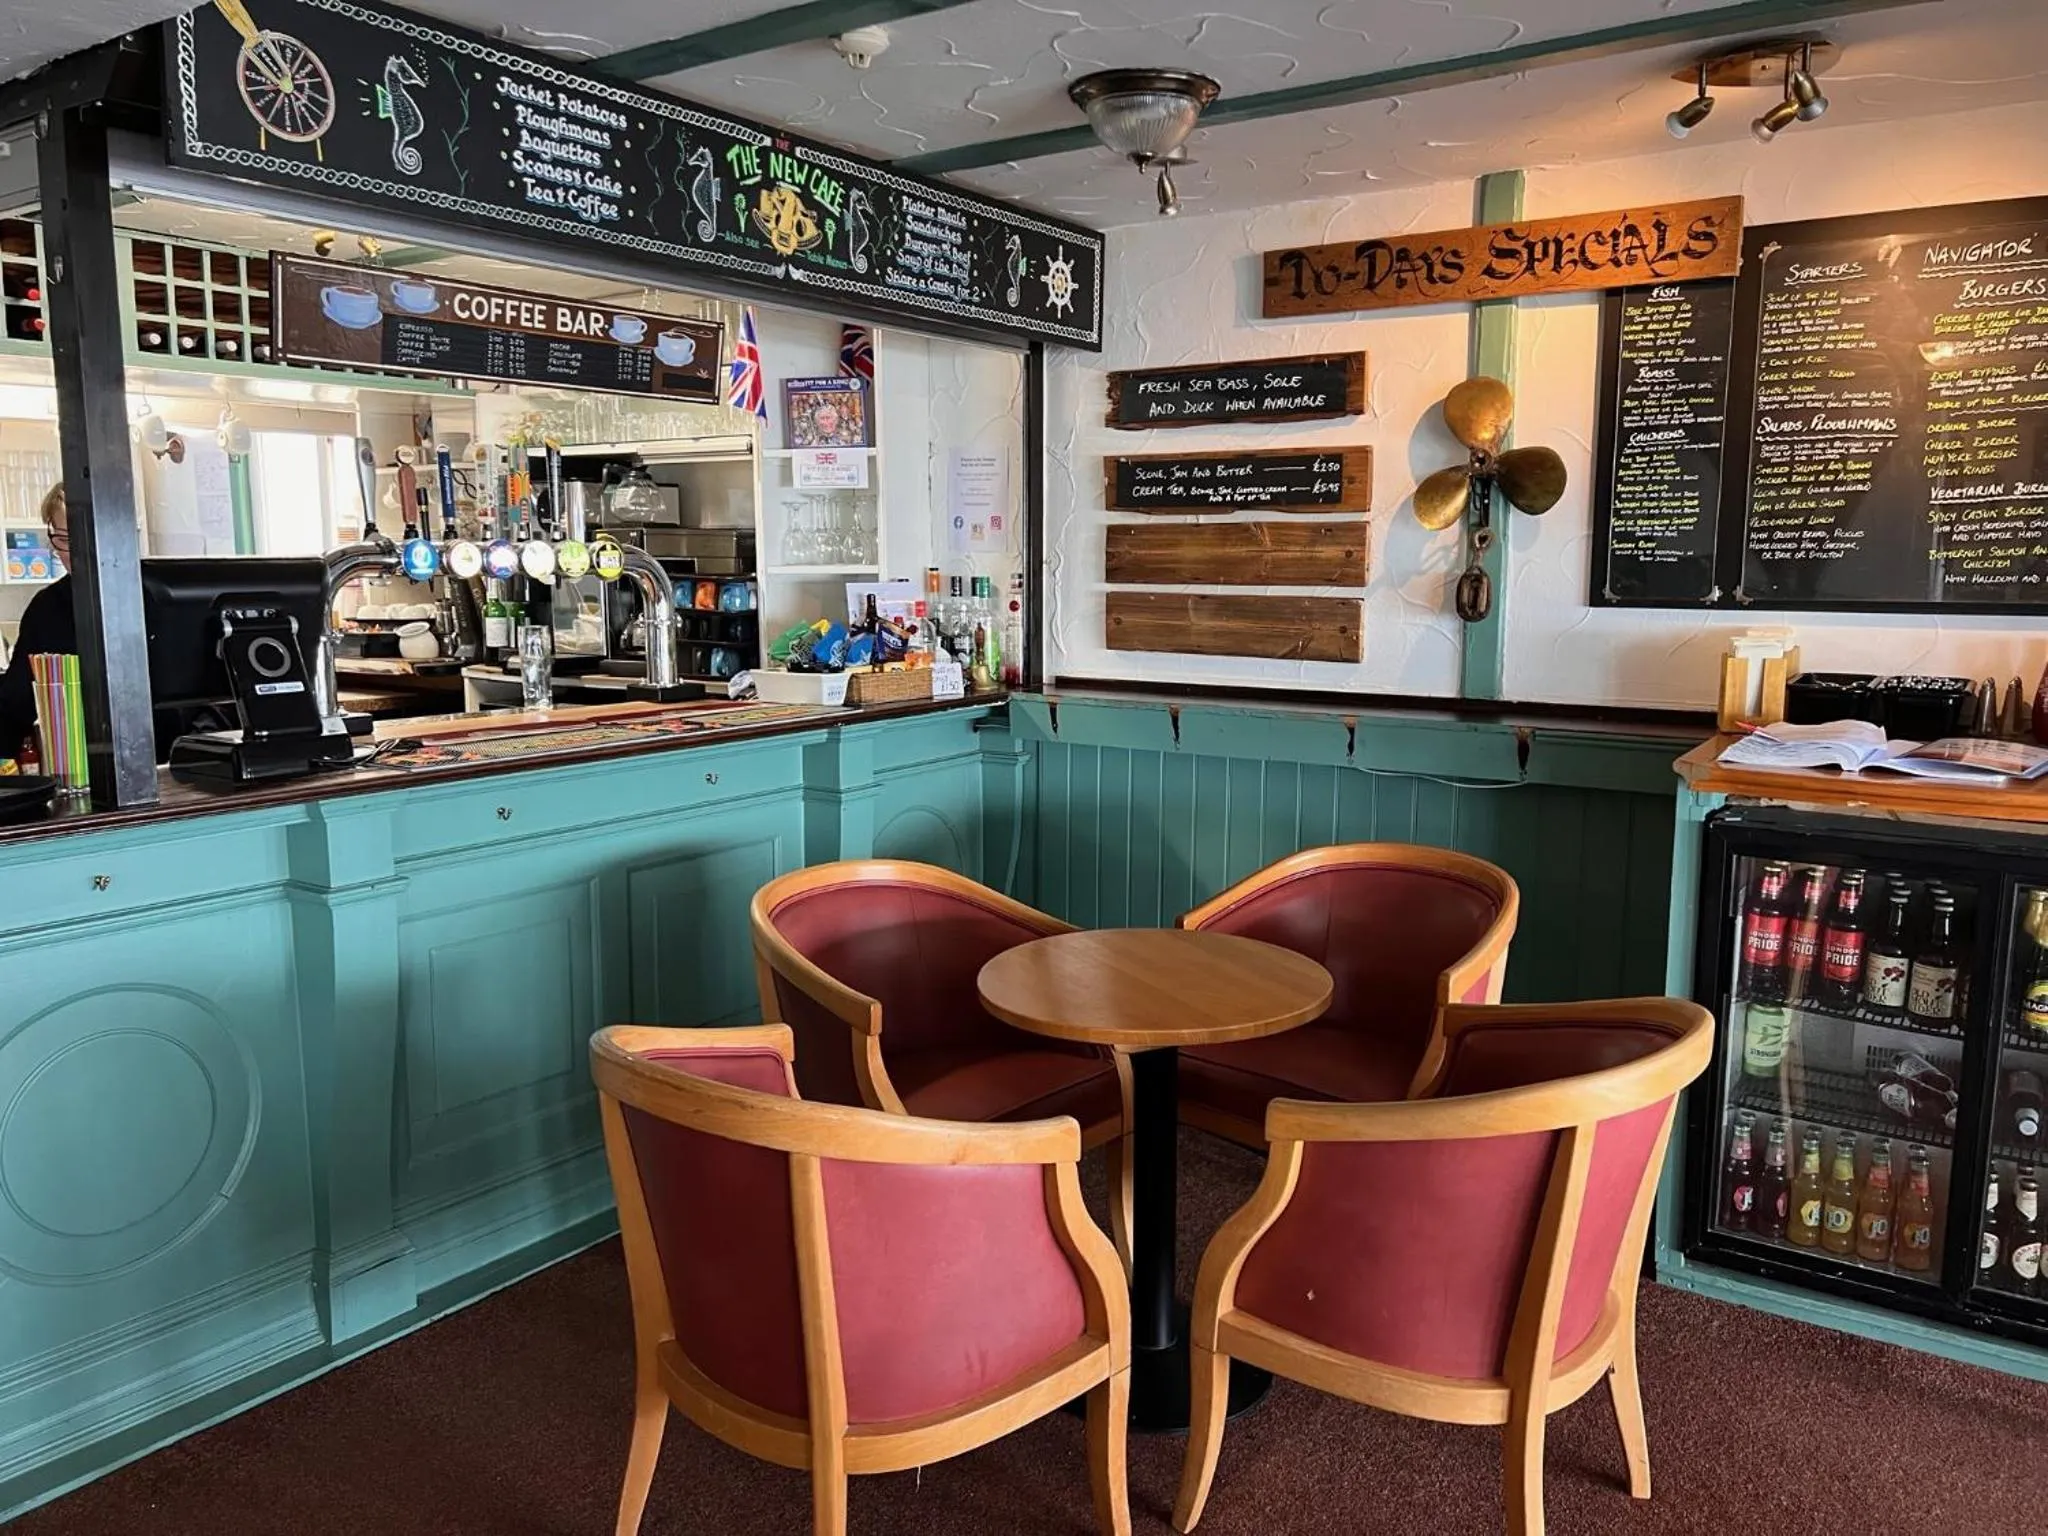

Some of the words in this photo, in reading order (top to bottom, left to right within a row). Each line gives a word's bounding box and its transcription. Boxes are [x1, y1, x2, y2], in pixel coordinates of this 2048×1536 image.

[496, 76, 555, 109] Jacket
[558, 93, 627, 128] Potatoes
[515, 104, 612, 148] Ploughmans
[520, 128, 602, 166] Baguettes
[726, 144, 762, 179] THE
[770, 152, 809, 185] NEW
[585, 171, 623, 197] Cake
[522, 177, 555, 203] Tea
[568, 189, 620, 222] Coffee
[902, 196, 935, 218] Platter
[905, 214, 962, 244] Sandwiches
[896, 249, 922, 273] Soup
[953, 264, 970, 286] Day
[1784, 261, 1864, 282] STARTERS
[886, 267, 917, 287] Share
[919, 279, 926, 288] a
[973, 286, 980, 301] 2
[1652, 286, 1680, 298] FISH
[454, 292, 546, 330] COFFEE
[556, 307, 605, 337] BAR
[1639, 366, 1676, 378] ROASTS
[1930, 370, 1963, 381] EXTRA
[1138, 381, 1181, 395] FRESH
[1188, 379, 1212, 392] SEA
[1264, 374, 1302, 389] SOLE
[1150, 401, 1176, 417] AND
[1183, 400, 1214, 414] DUCK
[1226, 398, 1256, 412] WHEN
[1263, 395, 1327, 410] AVAILABLE
[1977, 418, 2017, 429] BURGER
[1925, 440, 1964, 450] CHEESE
[1972, 434, 2020, 446] BURGER
[1924, 455, 1944, 465] NEW
[1977, 449, 2017, 459] BURGER
[1170, 465, 1188, 480] JAM
[1192, 466, 1211, 478] AND
[1216, 464, 1253, 477] BUTTER
[1756, 464, 1790, 474] SMOKED
[1792, 463, 1825, 473] SALMON
[1963, 464, 1996, 475] RINGS
[1754, 477, 1788, 486] CHICKEN
[1132, 485, 1163, 497] CREAM
[1930, 484, 2004, 499] VEGETARIAN
[1807, 515, 1836, 525] LUNCH
[1927, 511, 1957, 523] SPICY
[2005, 507, 2045, 517] BURGER
[2018, 531, 2042, 539] MAYO
[1929, 549, 1984, 560] BUTTERNUT
[2022, 574, 2041, 583] AND
[1748, 936, 1780, 950] PRIDE
[1825, 952, 1860, 966] PRIDE
